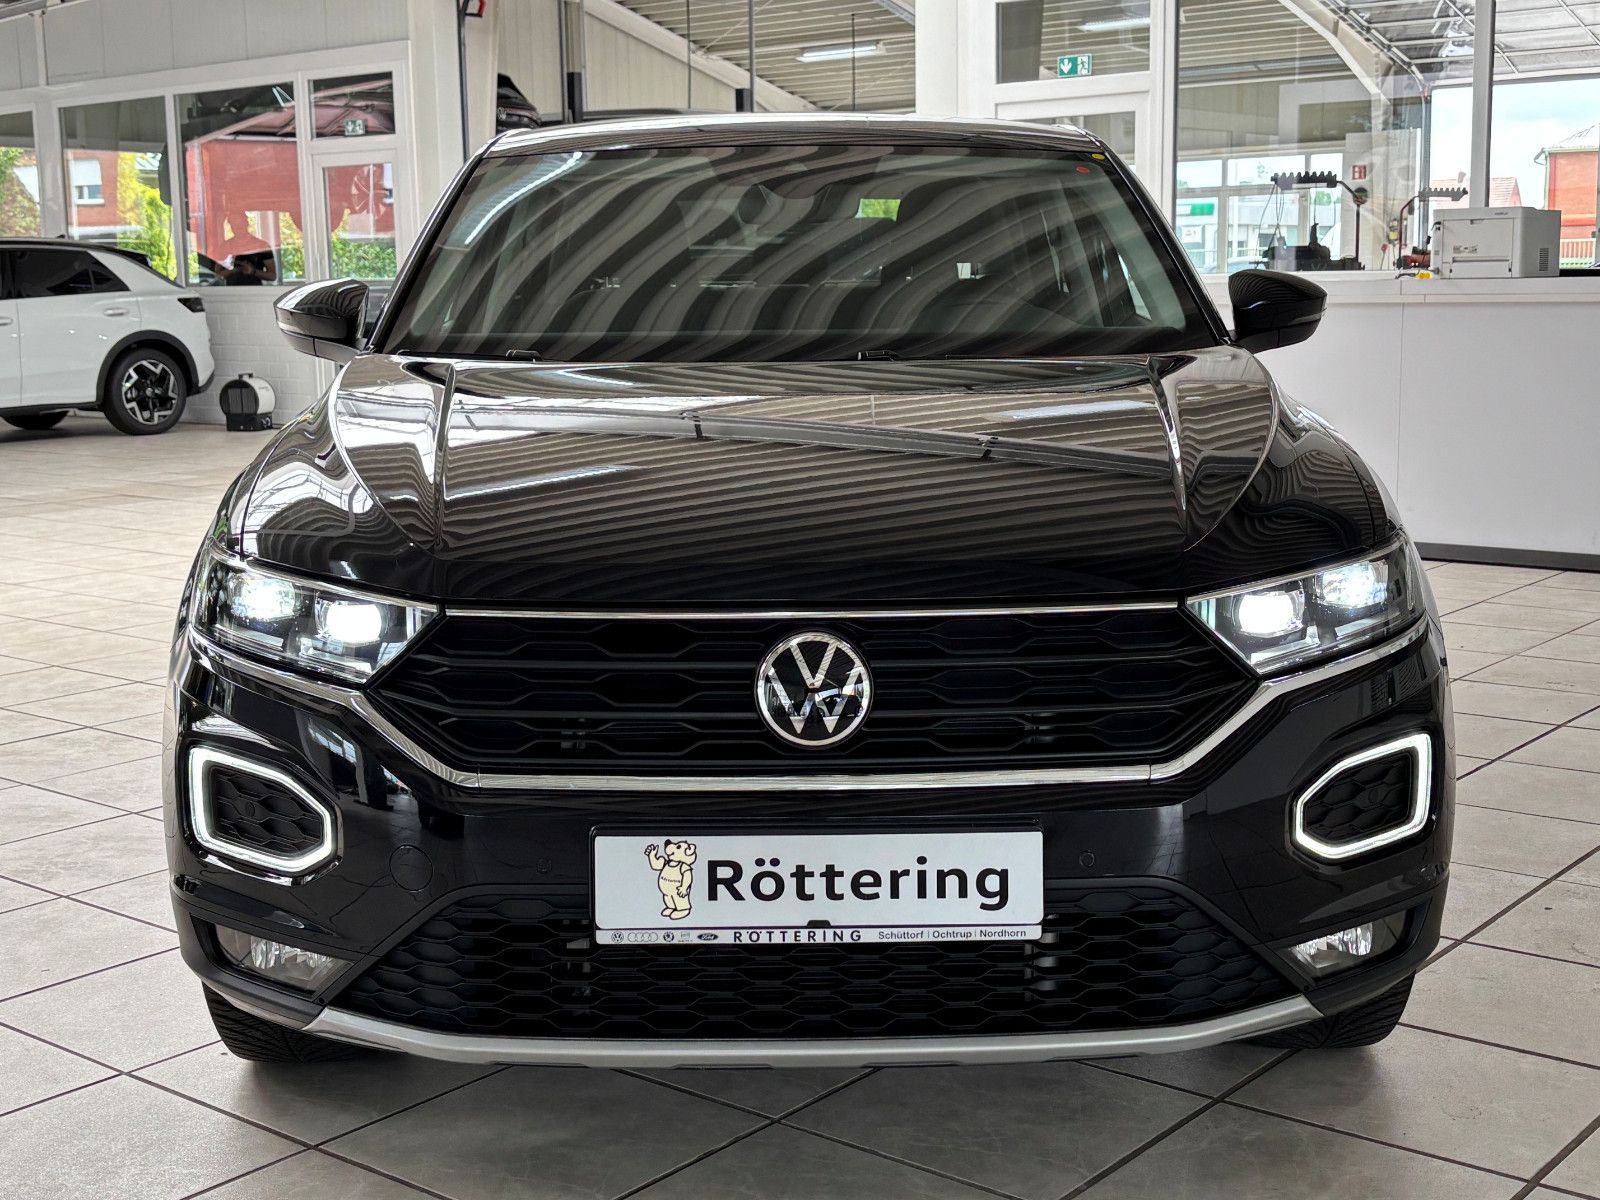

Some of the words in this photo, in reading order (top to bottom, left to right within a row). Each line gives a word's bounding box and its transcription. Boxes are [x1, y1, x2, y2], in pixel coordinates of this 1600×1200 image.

[757, 632, 871, 746] VW
[708, 856, 1008, 911] Röttering
[733, 929, 862, 943] RÖTTERING
[878, 929, 924, 940] Schüttorf
[931, 928, 972, 939] Ochtrup
[979, 928, 1027, 938] Nordhorn
